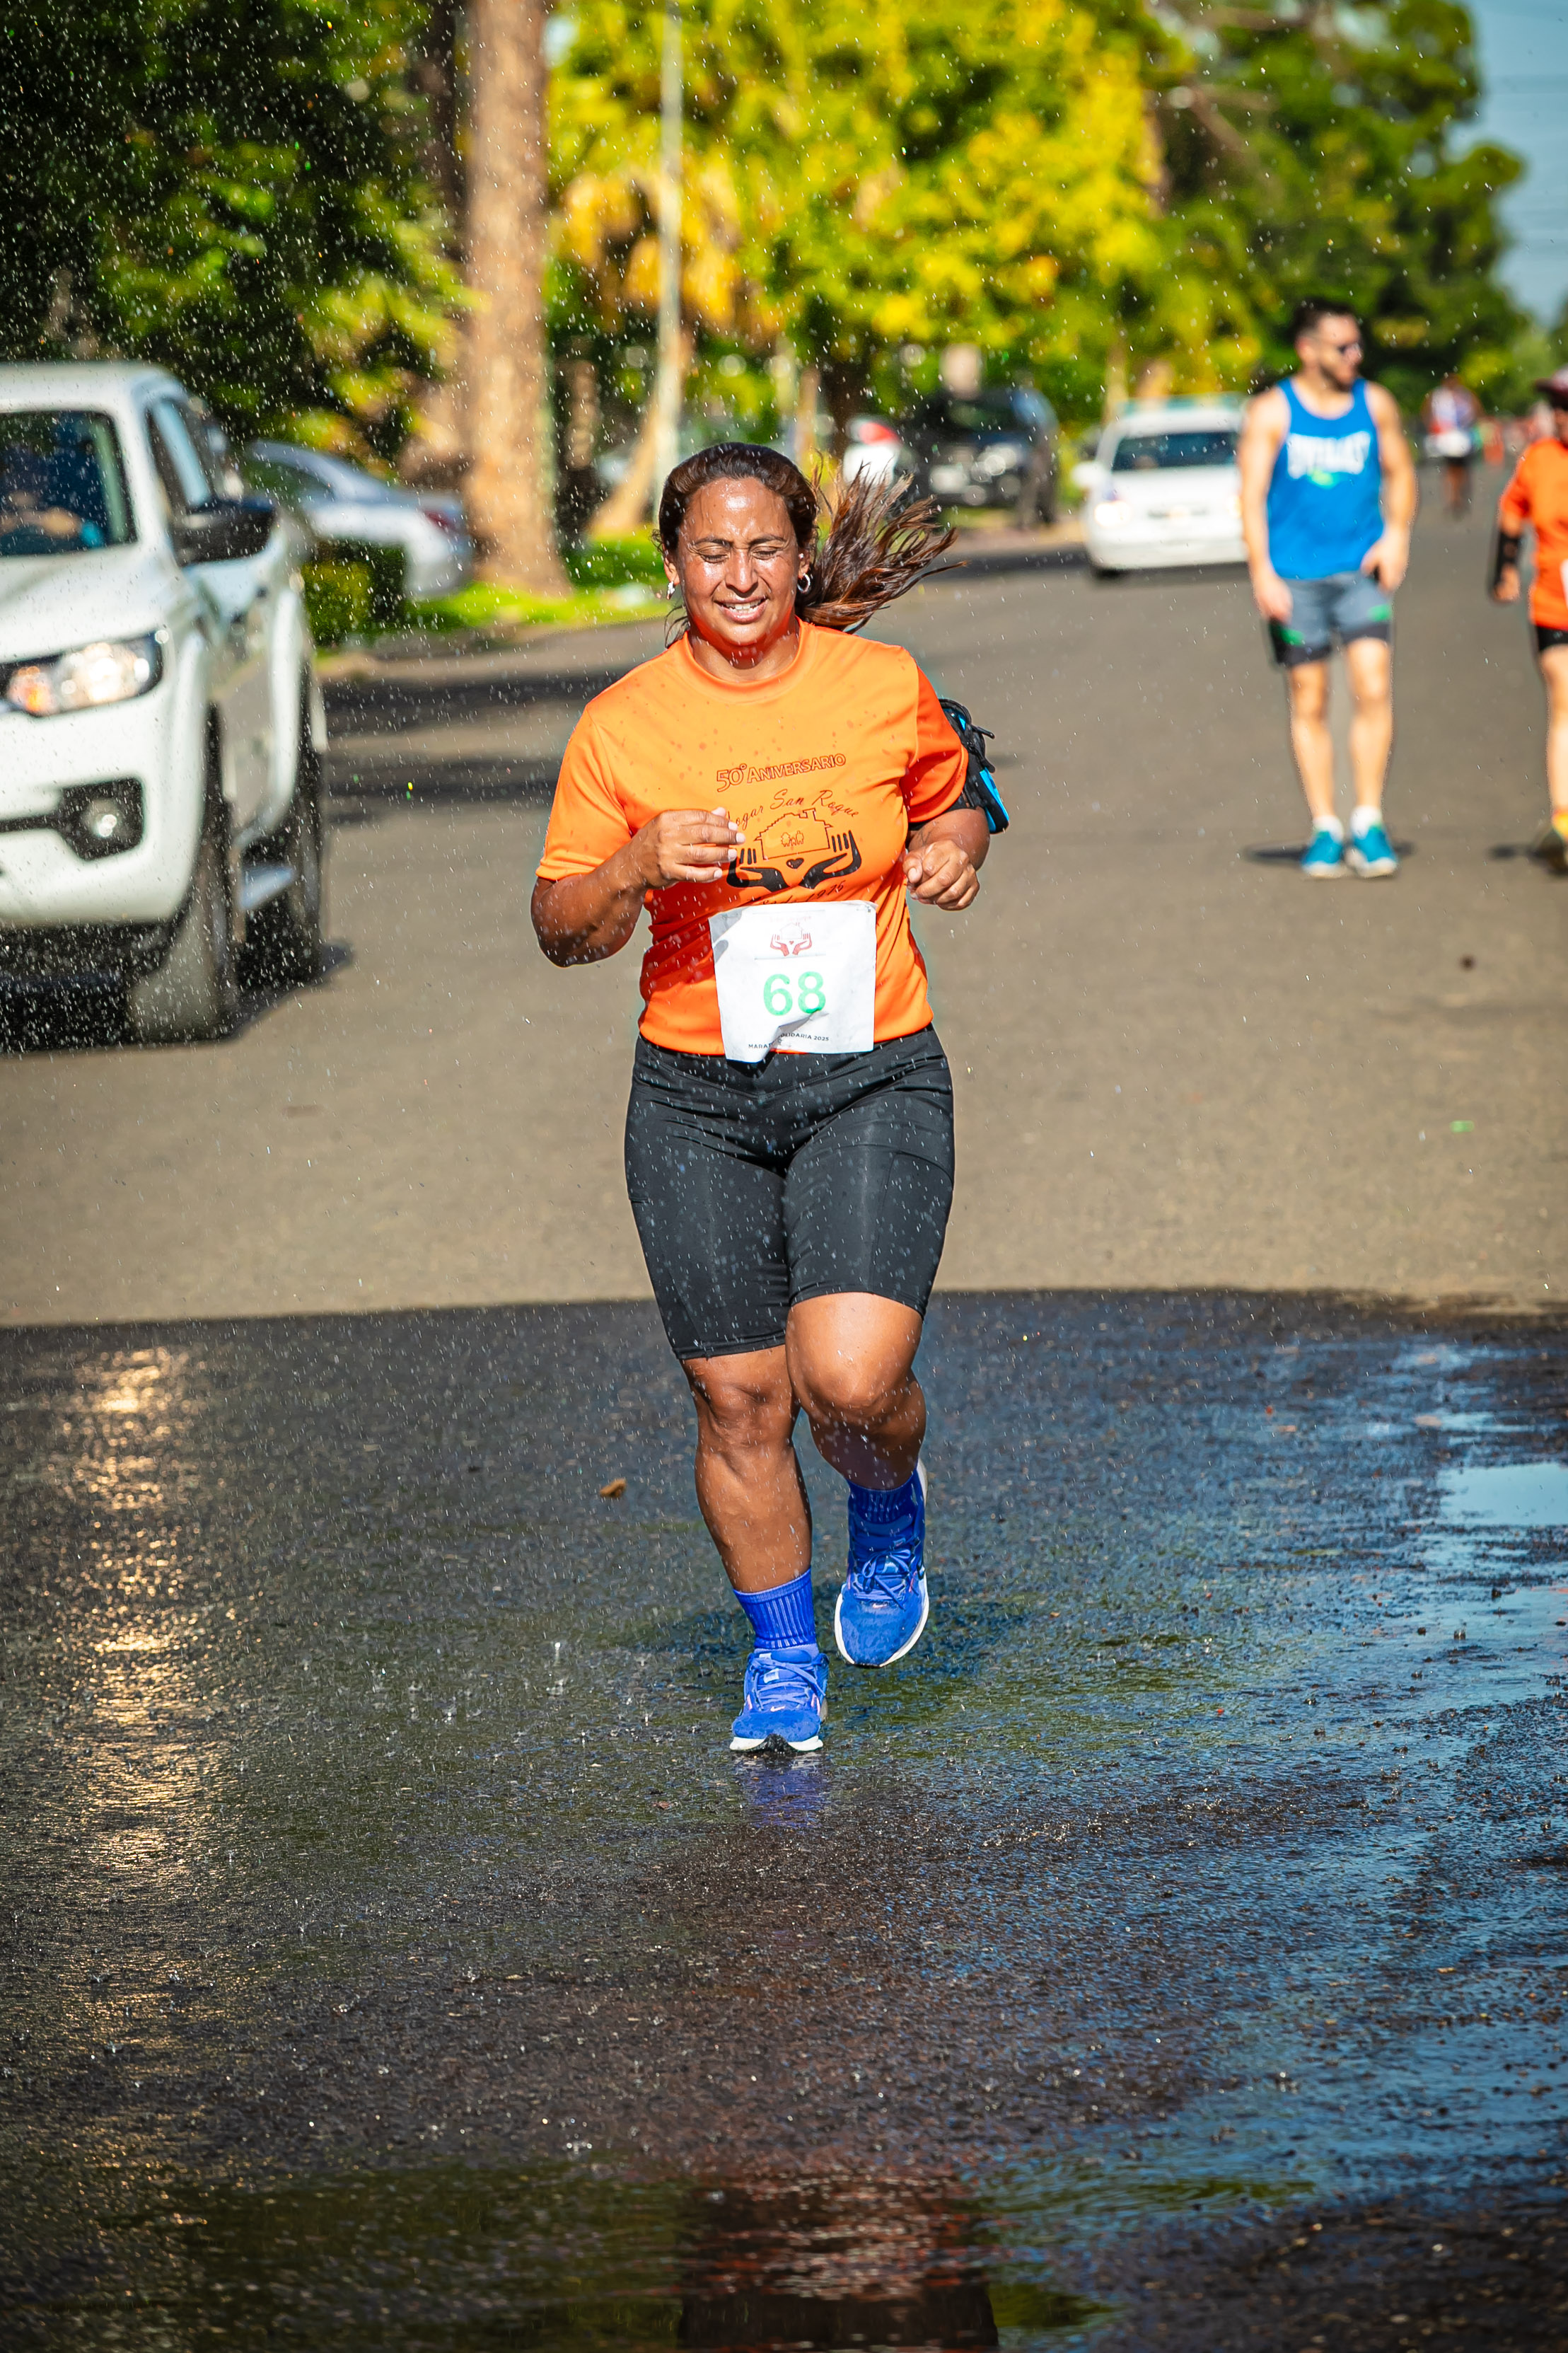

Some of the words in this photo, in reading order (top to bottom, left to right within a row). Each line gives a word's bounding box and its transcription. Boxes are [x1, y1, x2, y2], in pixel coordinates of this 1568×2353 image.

[746, 753, 847, 783] ANIVERSARIO
[770, 788, 805, 811] San
[811, 789, 859, 818] Roque
[763, 971, 826, 1016] 68
